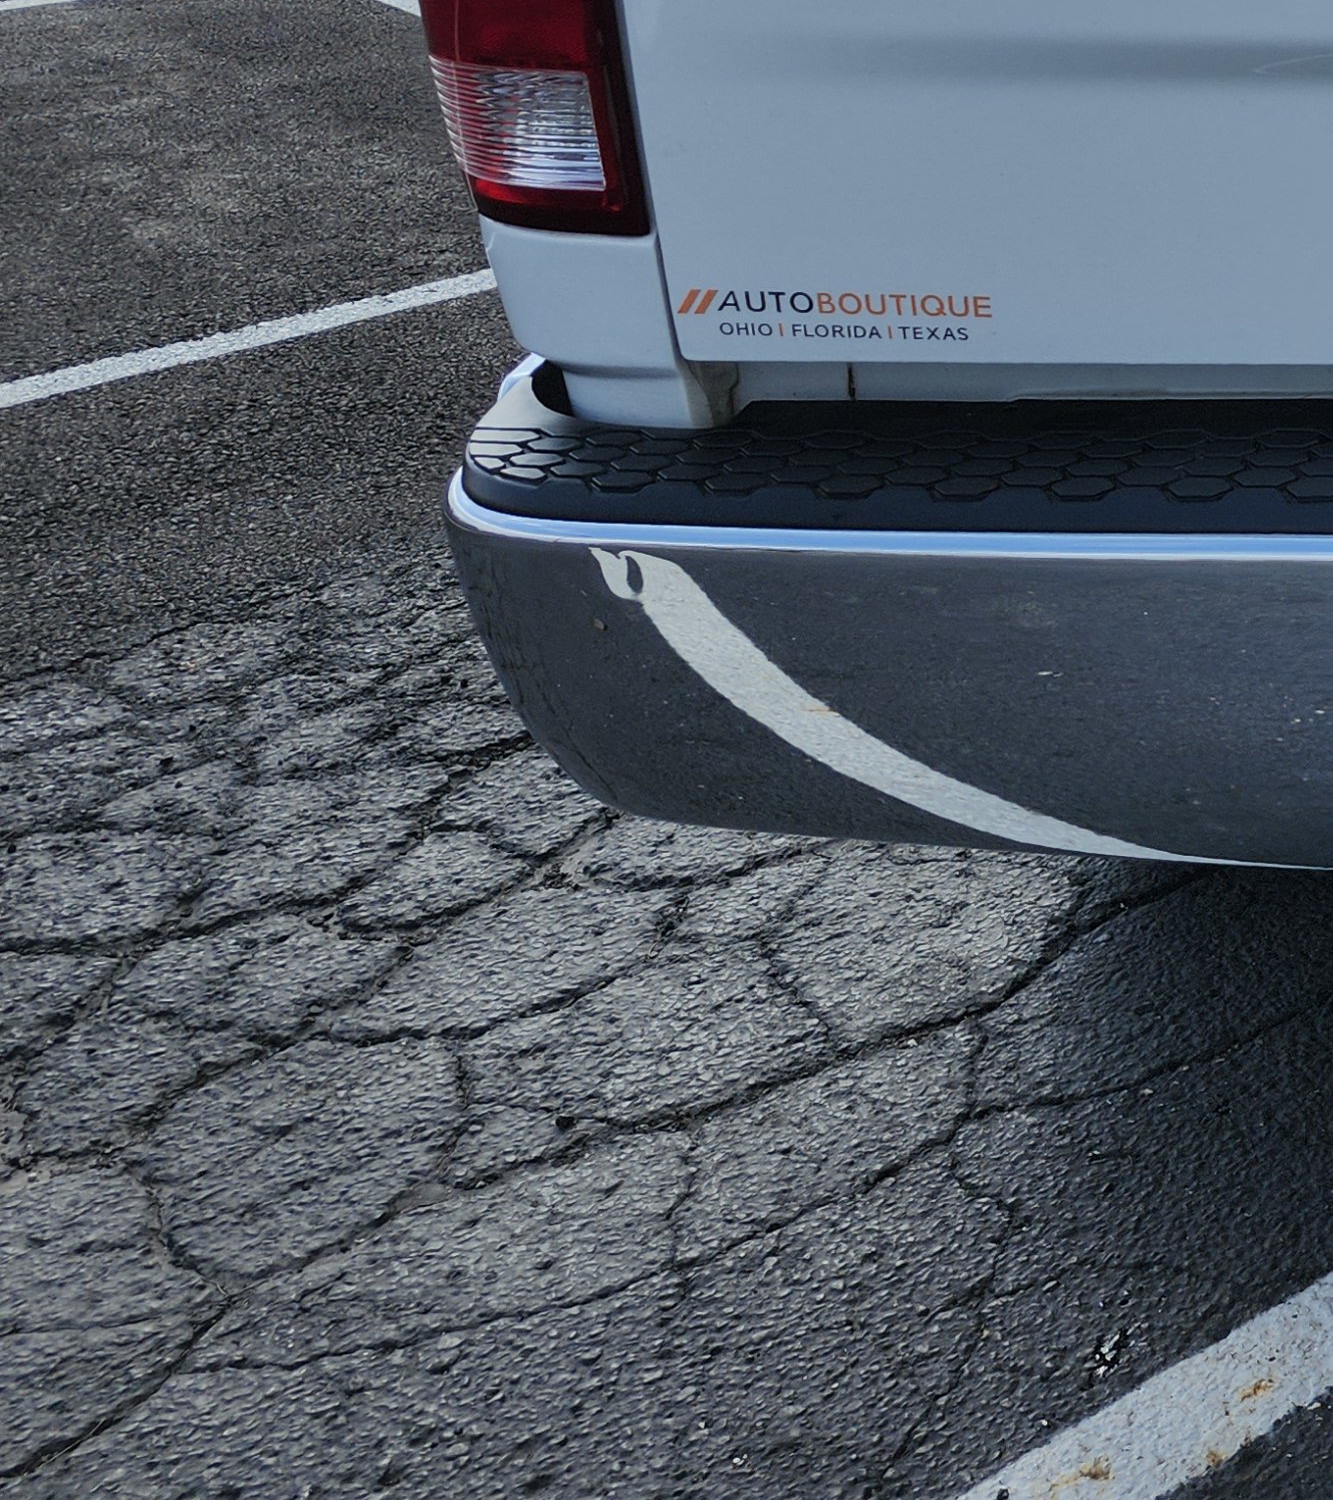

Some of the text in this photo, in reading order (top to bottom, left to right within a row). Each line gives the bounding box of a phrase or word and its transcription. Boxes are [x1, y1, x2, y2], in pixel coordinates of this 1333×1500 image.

[719, 322, 970, 341] OHIO FLORIDA TEXAS
